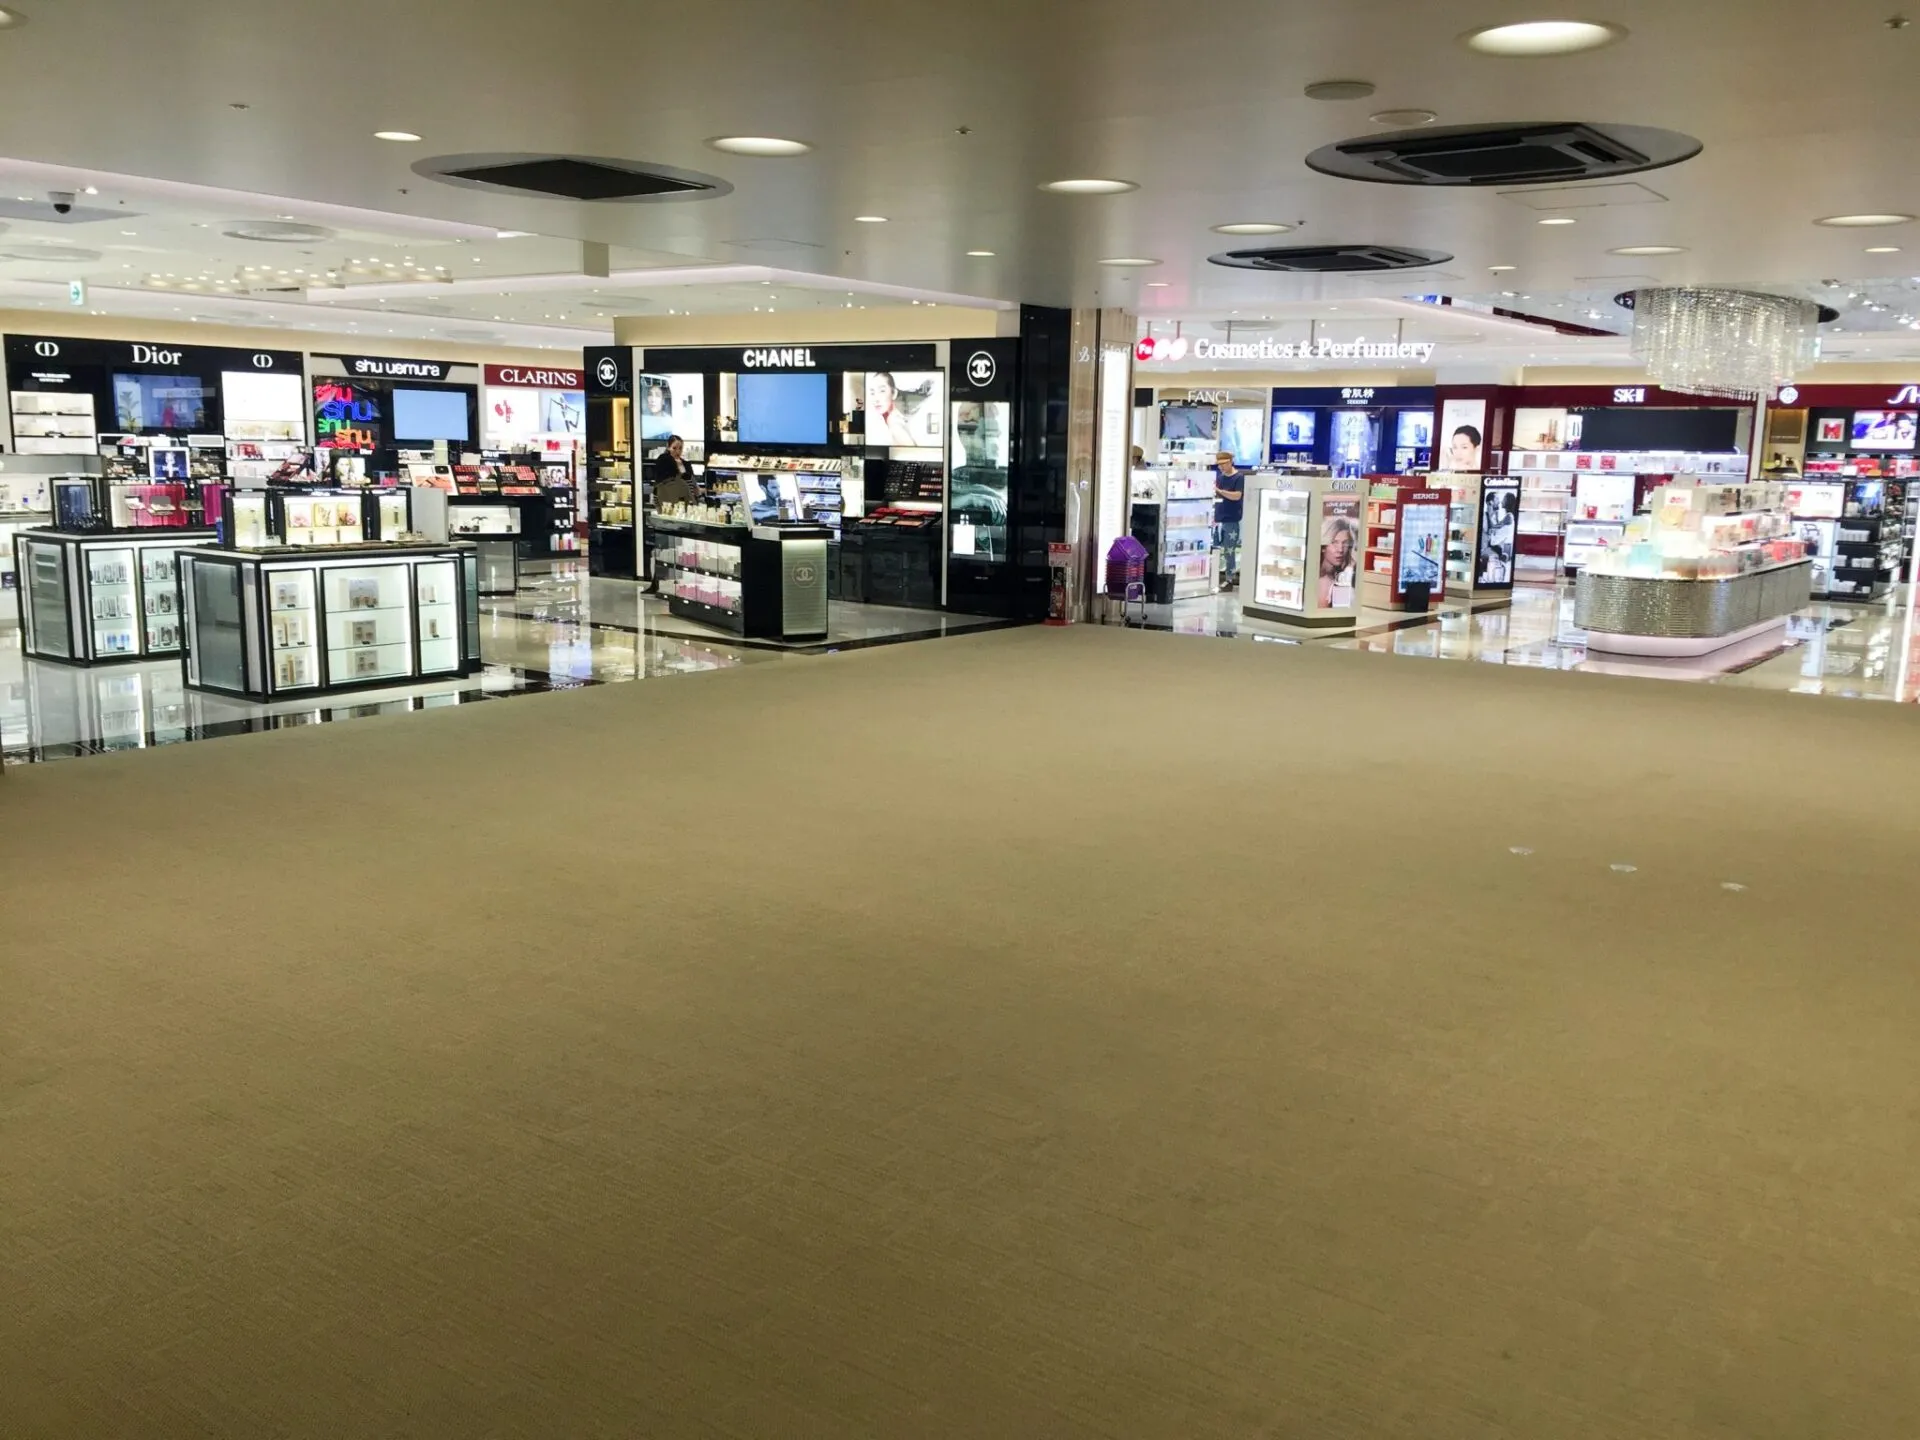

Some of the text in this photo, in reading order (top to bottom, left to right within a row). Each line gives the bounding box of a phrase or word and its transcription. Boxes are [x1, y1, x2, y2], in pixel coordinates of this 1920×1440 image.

[131, 344, 183, 365] Dior
[743, 349, 816, 368] CHANEL
[1194, 336, 1436, 363] Cosmetics & Perfumery
[355, 359, 441, 377] shu uemura
[500, 369, 578, 386] CLARINS
[1187, 390, 1234, 404] FANCL
[1613, 388, 1646, 403] SK-II
[323, 399, 372, 421] shu
[335, 427, 371, 445] shu
